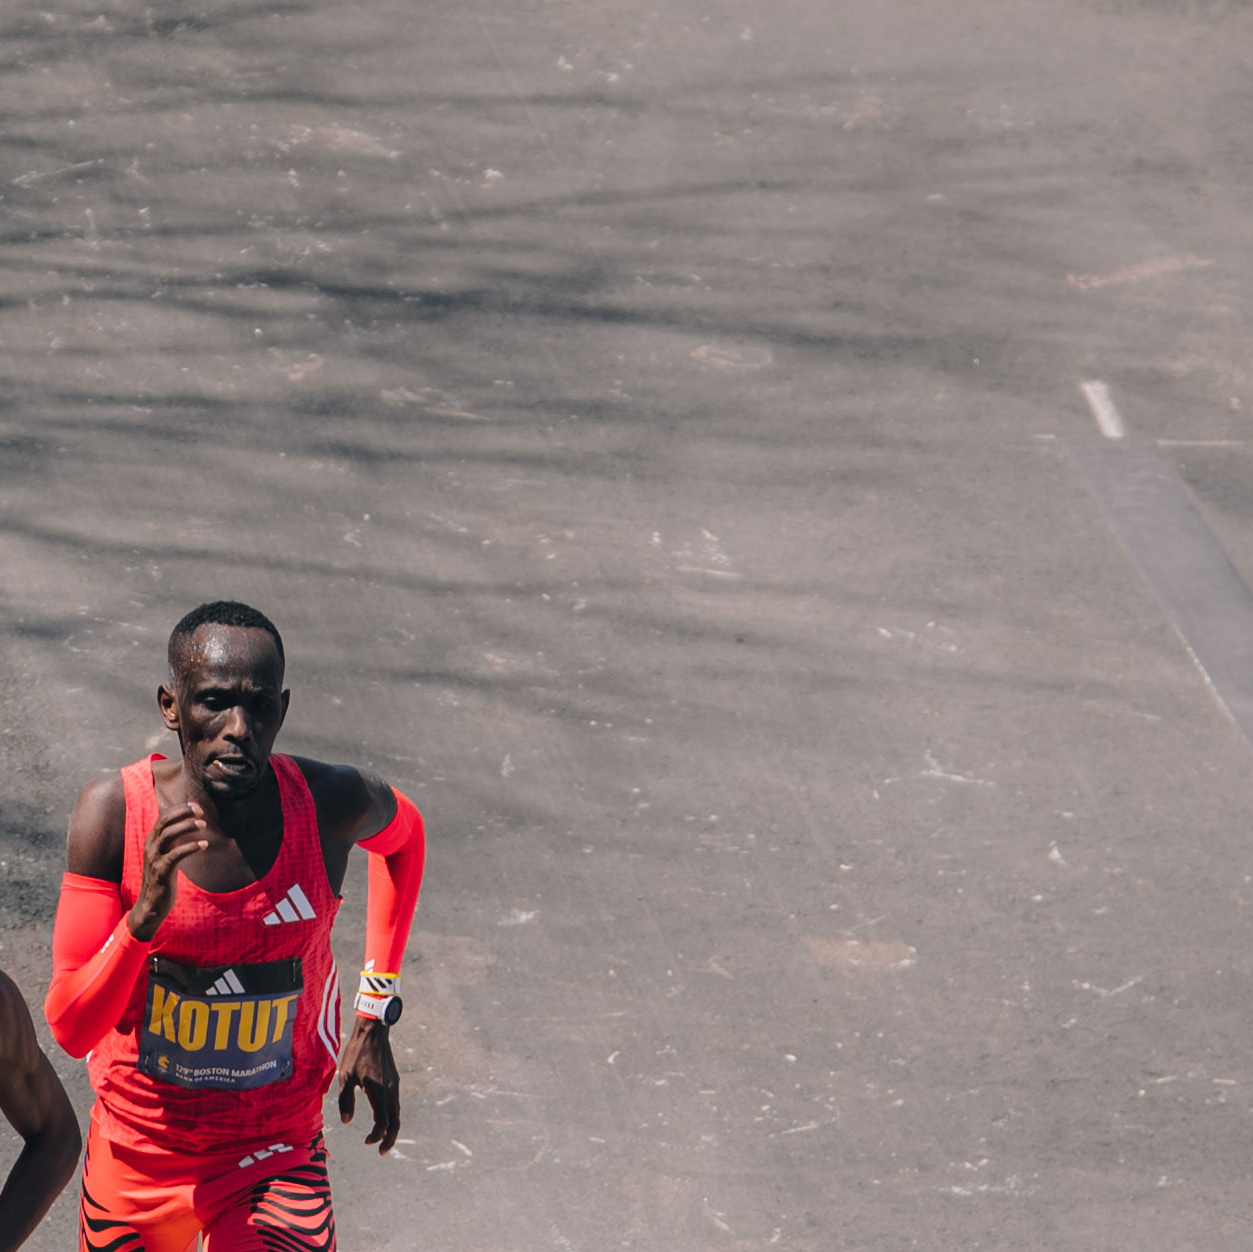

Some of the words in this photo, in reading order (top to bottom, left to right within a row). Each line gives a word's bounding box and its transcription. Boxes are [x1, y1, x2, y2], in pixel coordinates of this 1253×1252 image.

[148, 984, 299, 1053] KOTUT
[193, 1067, 230, 1077] BOSTON
[231, 1060, 277, 1077] MARATHON
